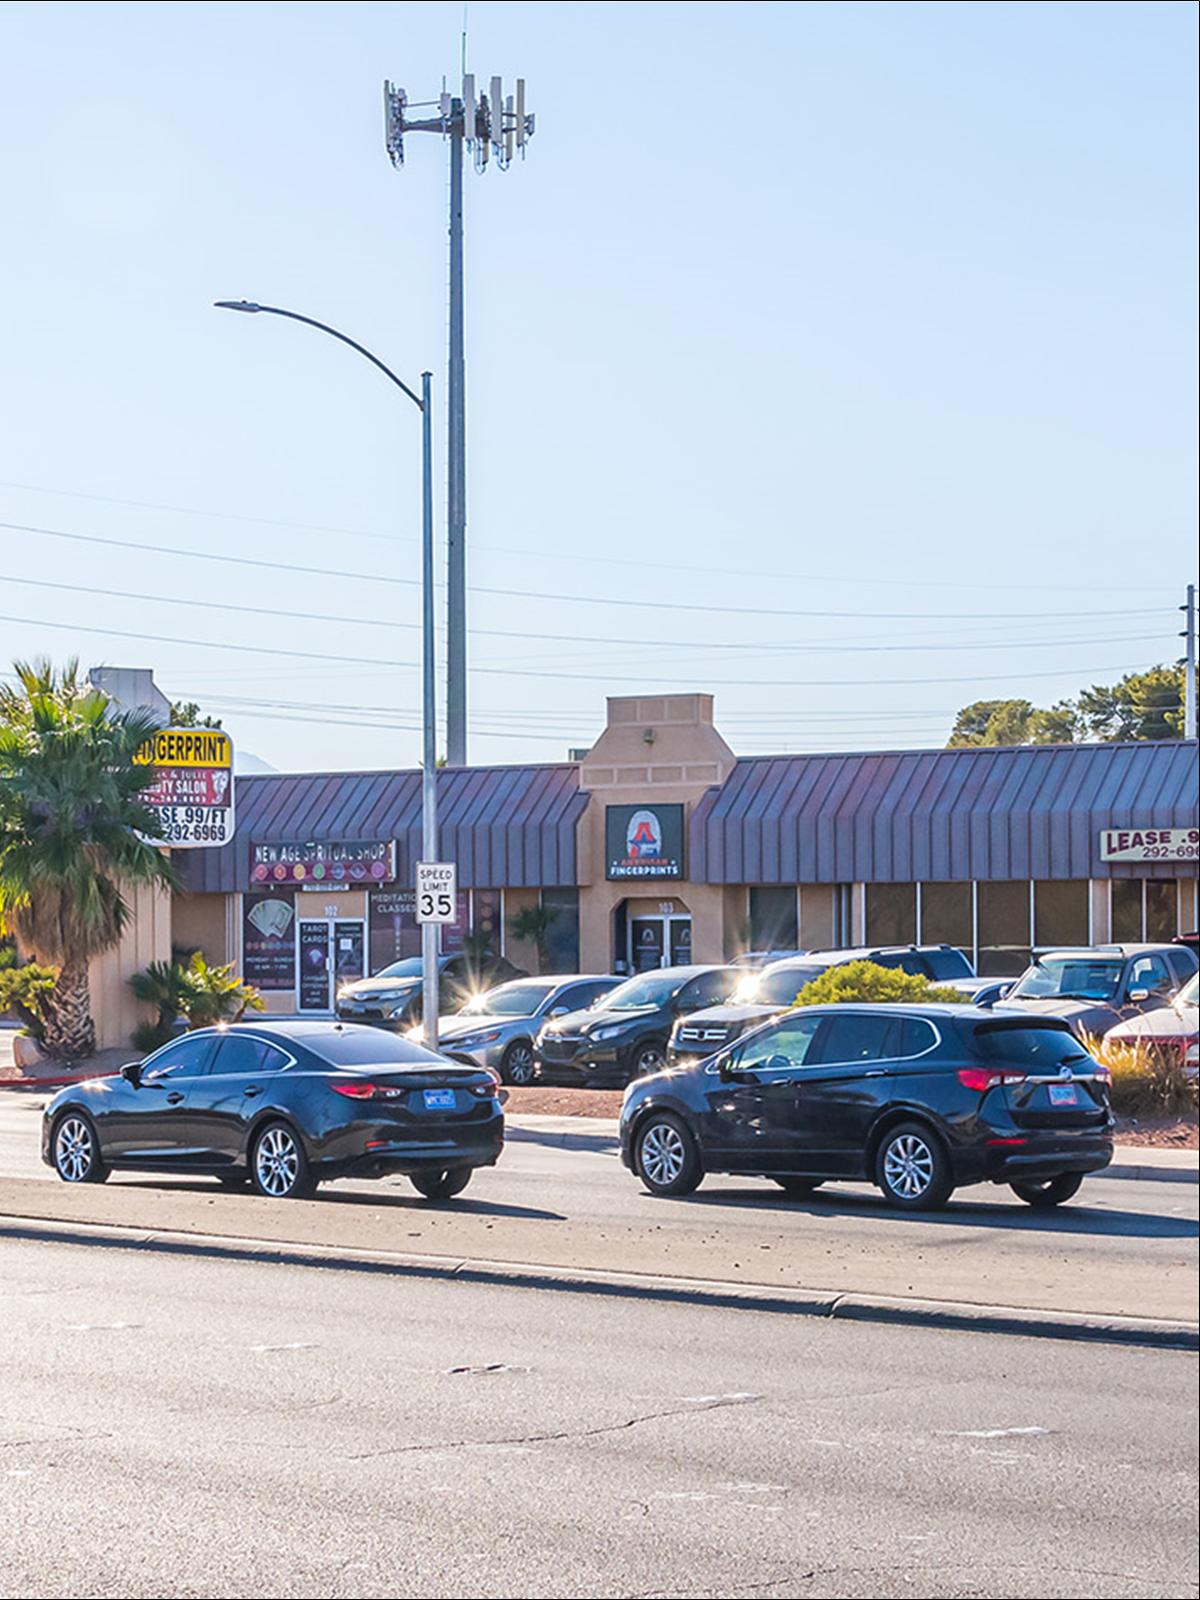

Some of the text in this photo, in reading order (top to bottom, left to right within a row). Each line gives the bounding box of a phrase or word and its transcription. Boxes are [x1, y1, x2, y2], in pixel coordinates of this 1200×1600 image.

[176, 781, 207, 794] SALON
[181, 808, 227, 825] .99/FT
[1107, 831, 1172, 855] LEASE
[255, 847, 277, 862] NEW
[280, 848, 300, 861] AGE
[358, 843, 386, 860] SHOP
[420, 869, 452, 880] SPEED
[611, 866, 678, 876] FINGERPRINTS
[423, 883, 448, 892] LIMIT
[371, 893, 416, 903] MEDITATI
[377, 904, 416, 914] CLASSES
[421, 894, 451, 916] 35
[659, 902, 674, 914] 103
[324, 905, 338, 917] 102
[302, 925, 327, 933] TAROT
[302, 936, 327, 944] CARDS
